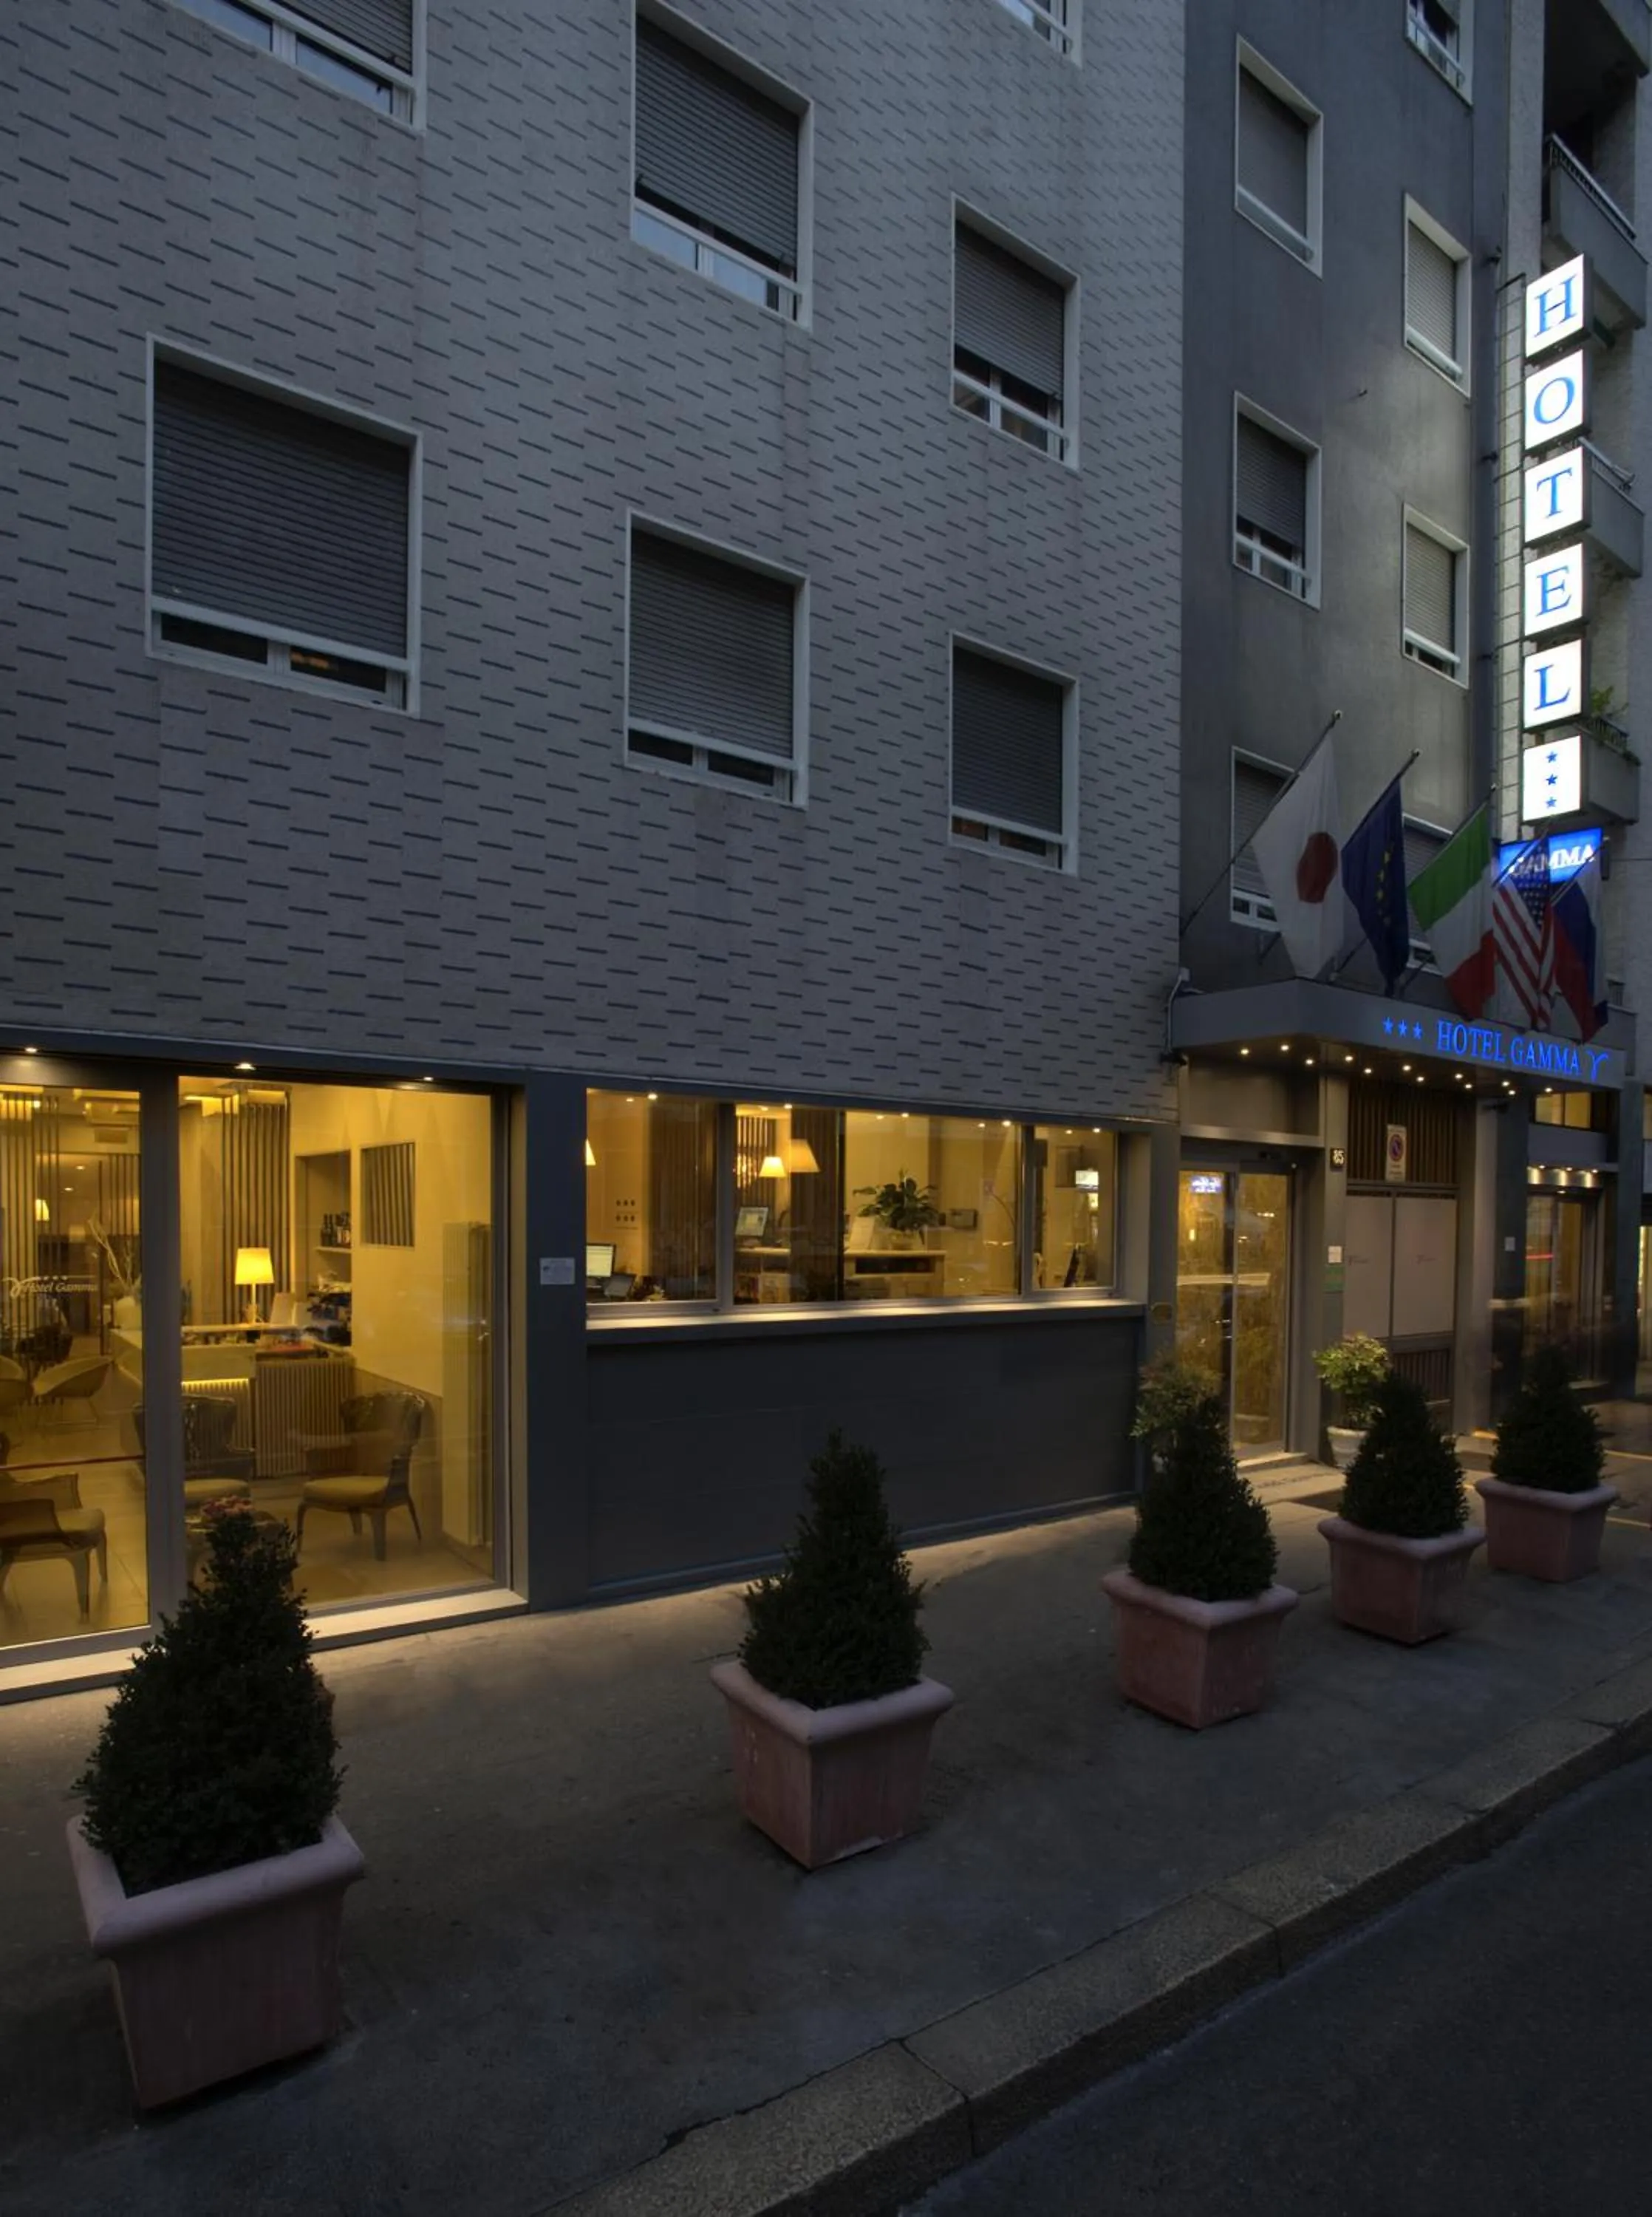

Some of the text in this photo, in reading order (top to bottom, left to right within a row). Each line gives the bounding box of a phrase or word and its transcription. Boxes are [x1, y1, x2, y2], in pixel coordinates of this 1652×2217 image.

[1533, 273, 1578, 712] HOTEL
[1436, 1018, 1506, 1064] HOTEL
[1510, 1036, 1582, 1076] GAMMA
